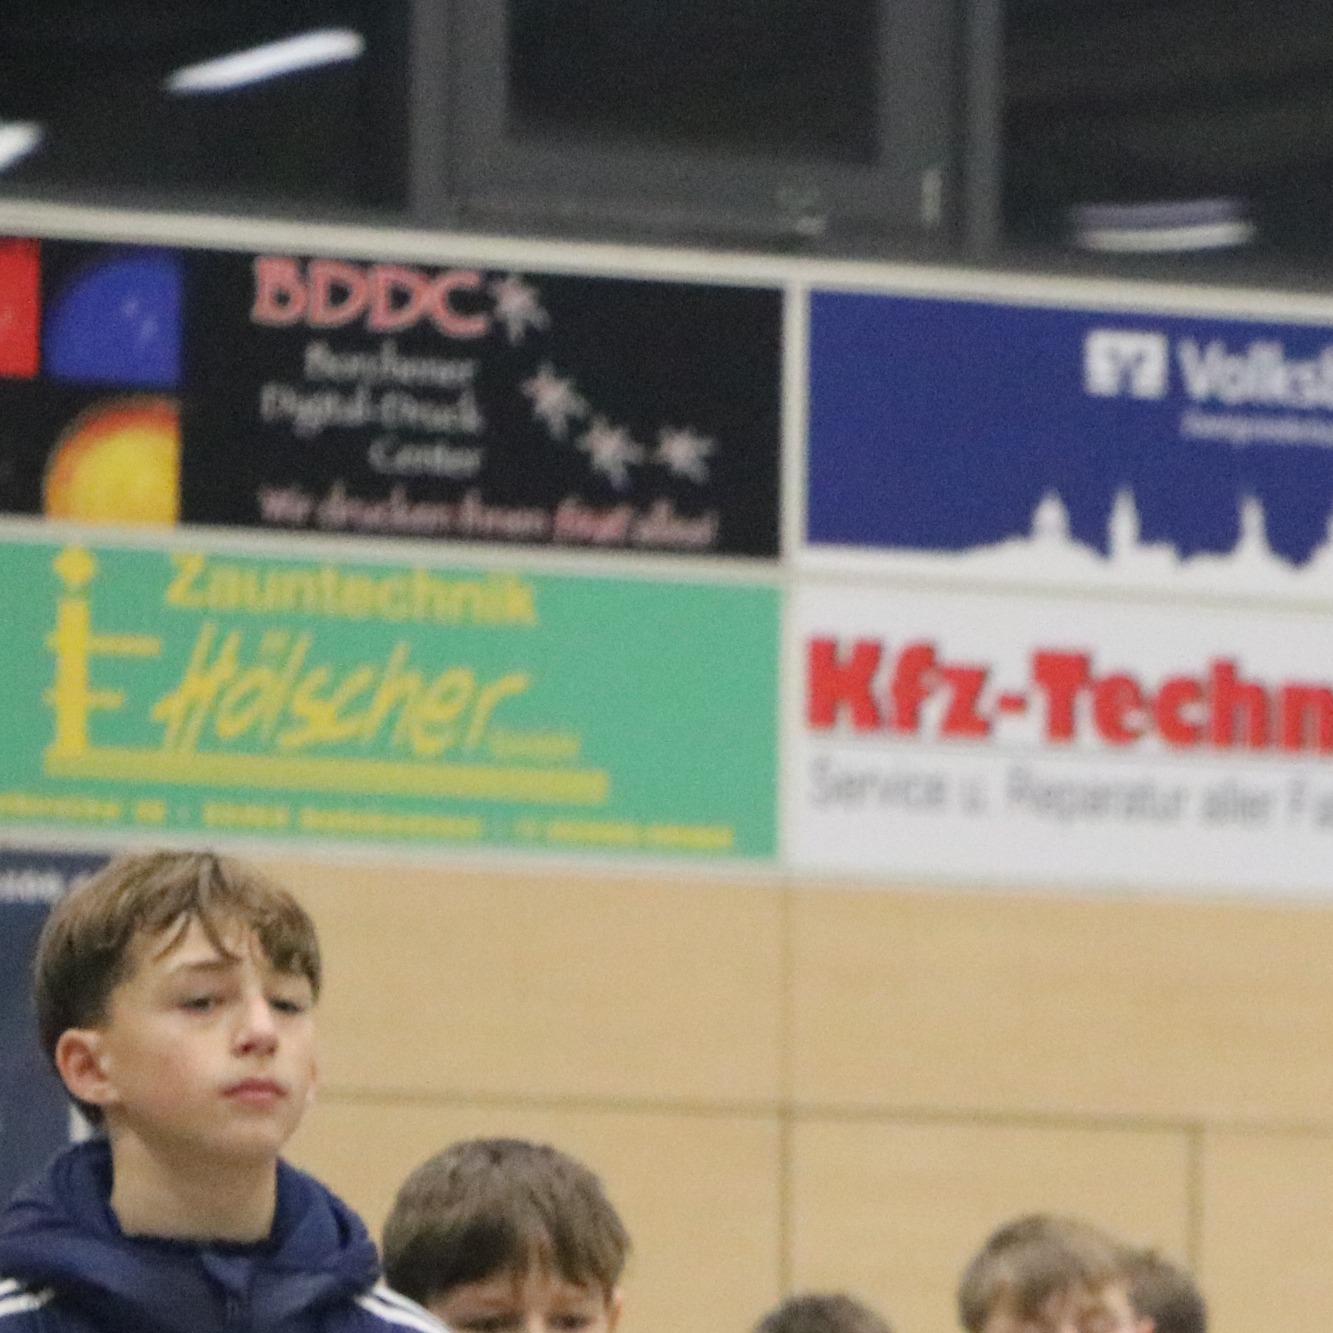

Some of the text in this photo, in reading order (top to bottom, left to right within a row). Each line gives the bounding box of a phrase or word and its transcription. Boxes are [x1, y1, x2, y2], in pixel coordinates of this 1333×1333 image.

[250, 256, 490, 338] BDDC
[164, 551, 538, 628] Zauntechnik
[152, 620, 534, 757] Hölscher
[808, 754, 946, 810] Service
[1005, 764, 1185, 829] Reparatur
